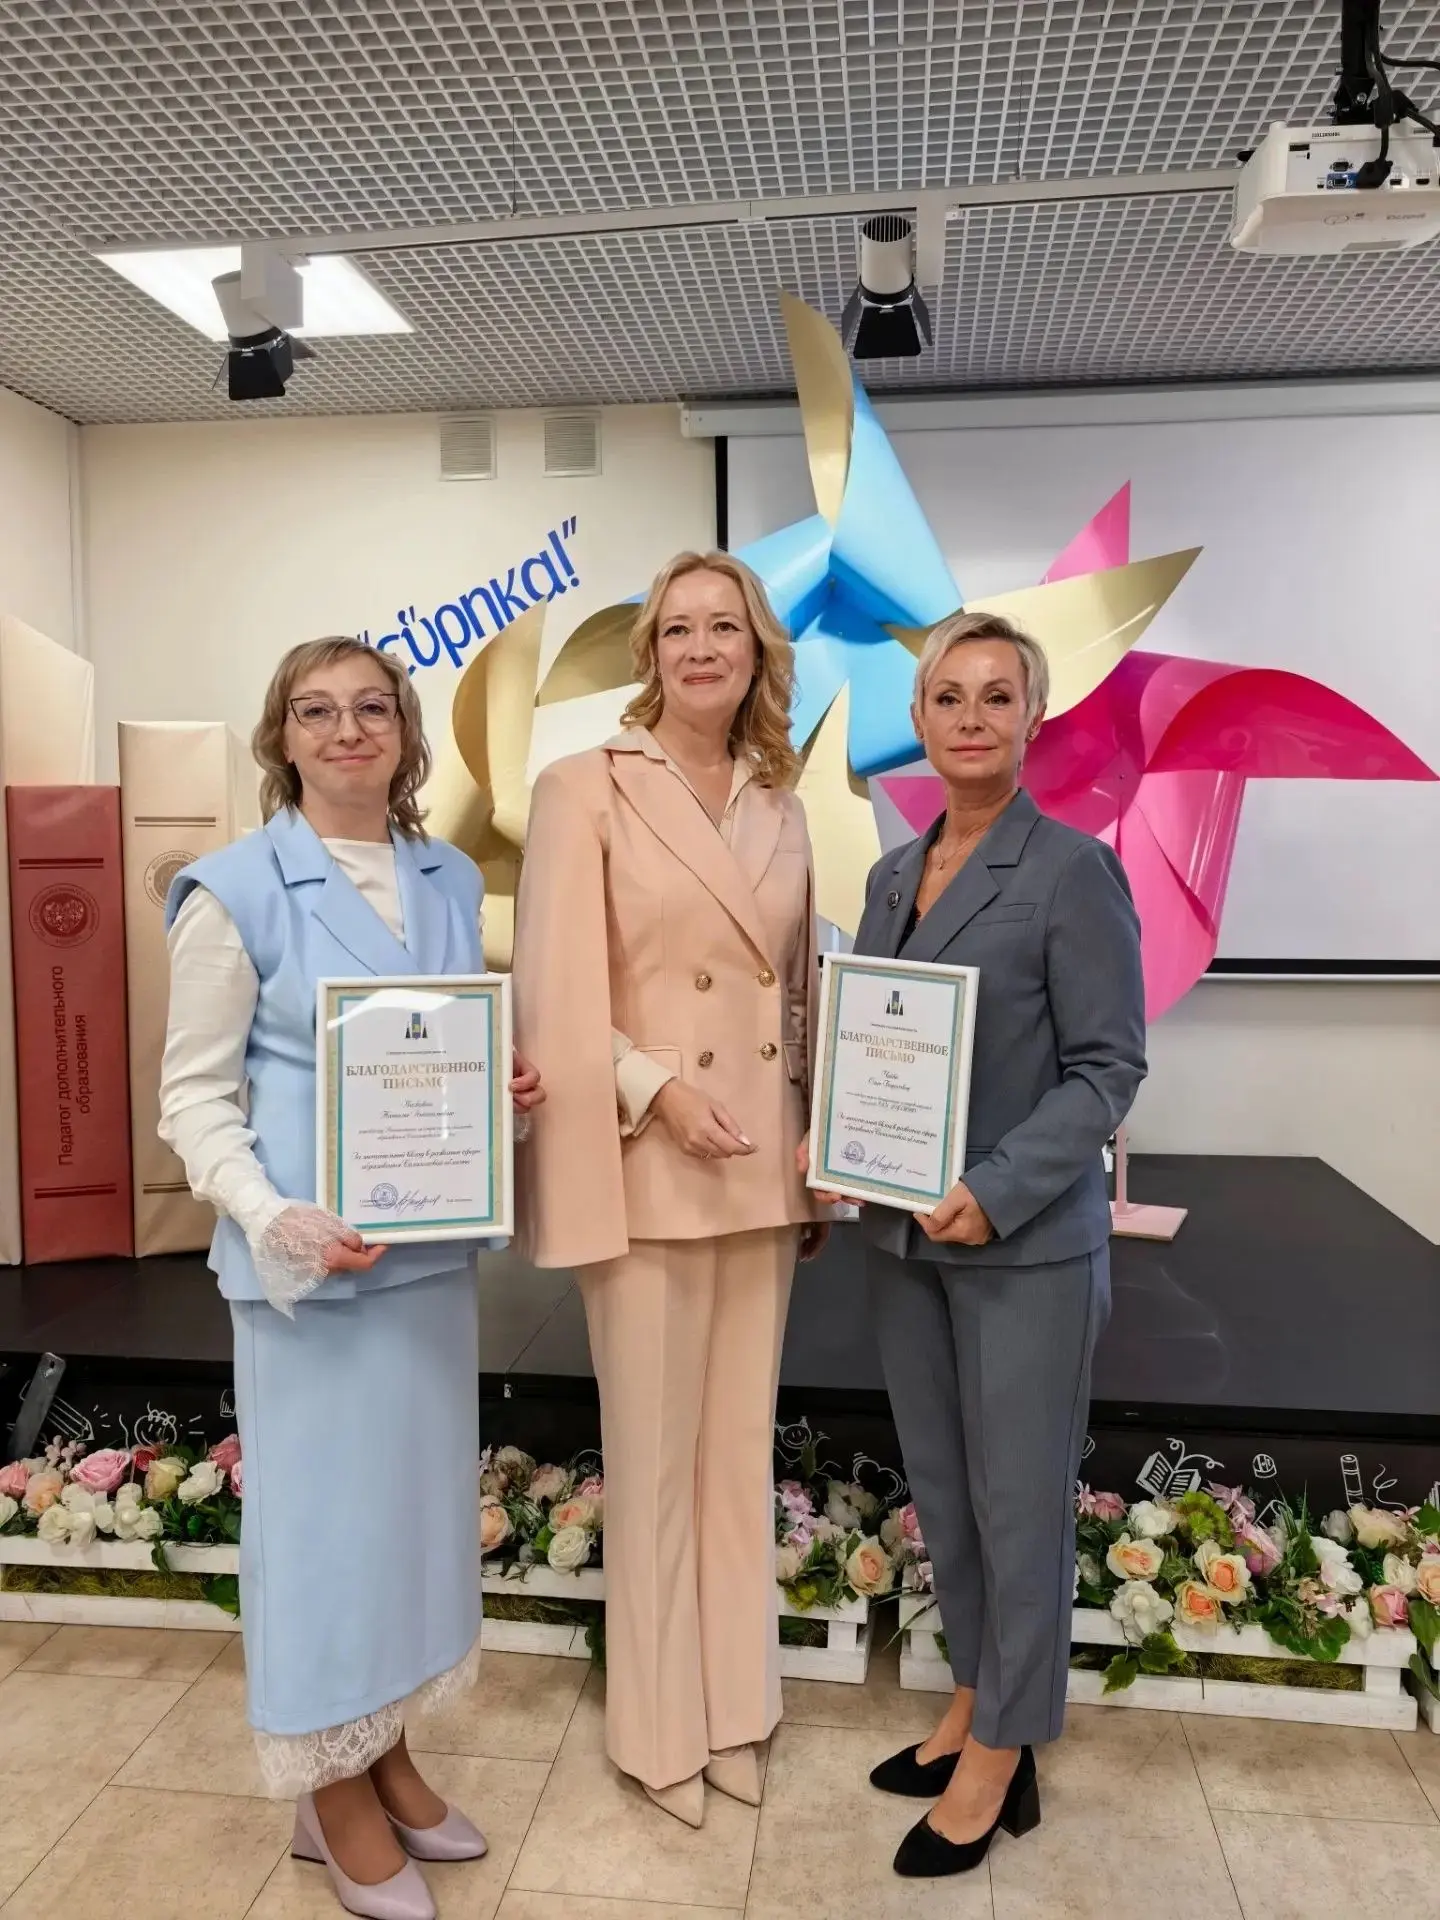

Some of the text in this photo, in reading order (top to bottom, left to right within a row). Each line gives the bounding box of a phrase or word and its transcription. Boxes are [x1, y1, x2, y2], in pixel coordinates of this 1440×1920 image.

[840, 1030, 949, 1056] БЛАГОДАРСТВЕННОЕ
[865, 1046, 915, 1064] ПИСЬМО
[52, 965, 74, 1166] Педагог дополнительного
[75, 1014, 93, 1115] образования
[346, 1061, 486, 1077] БЛАГОДАРСТВЕННОЕ
